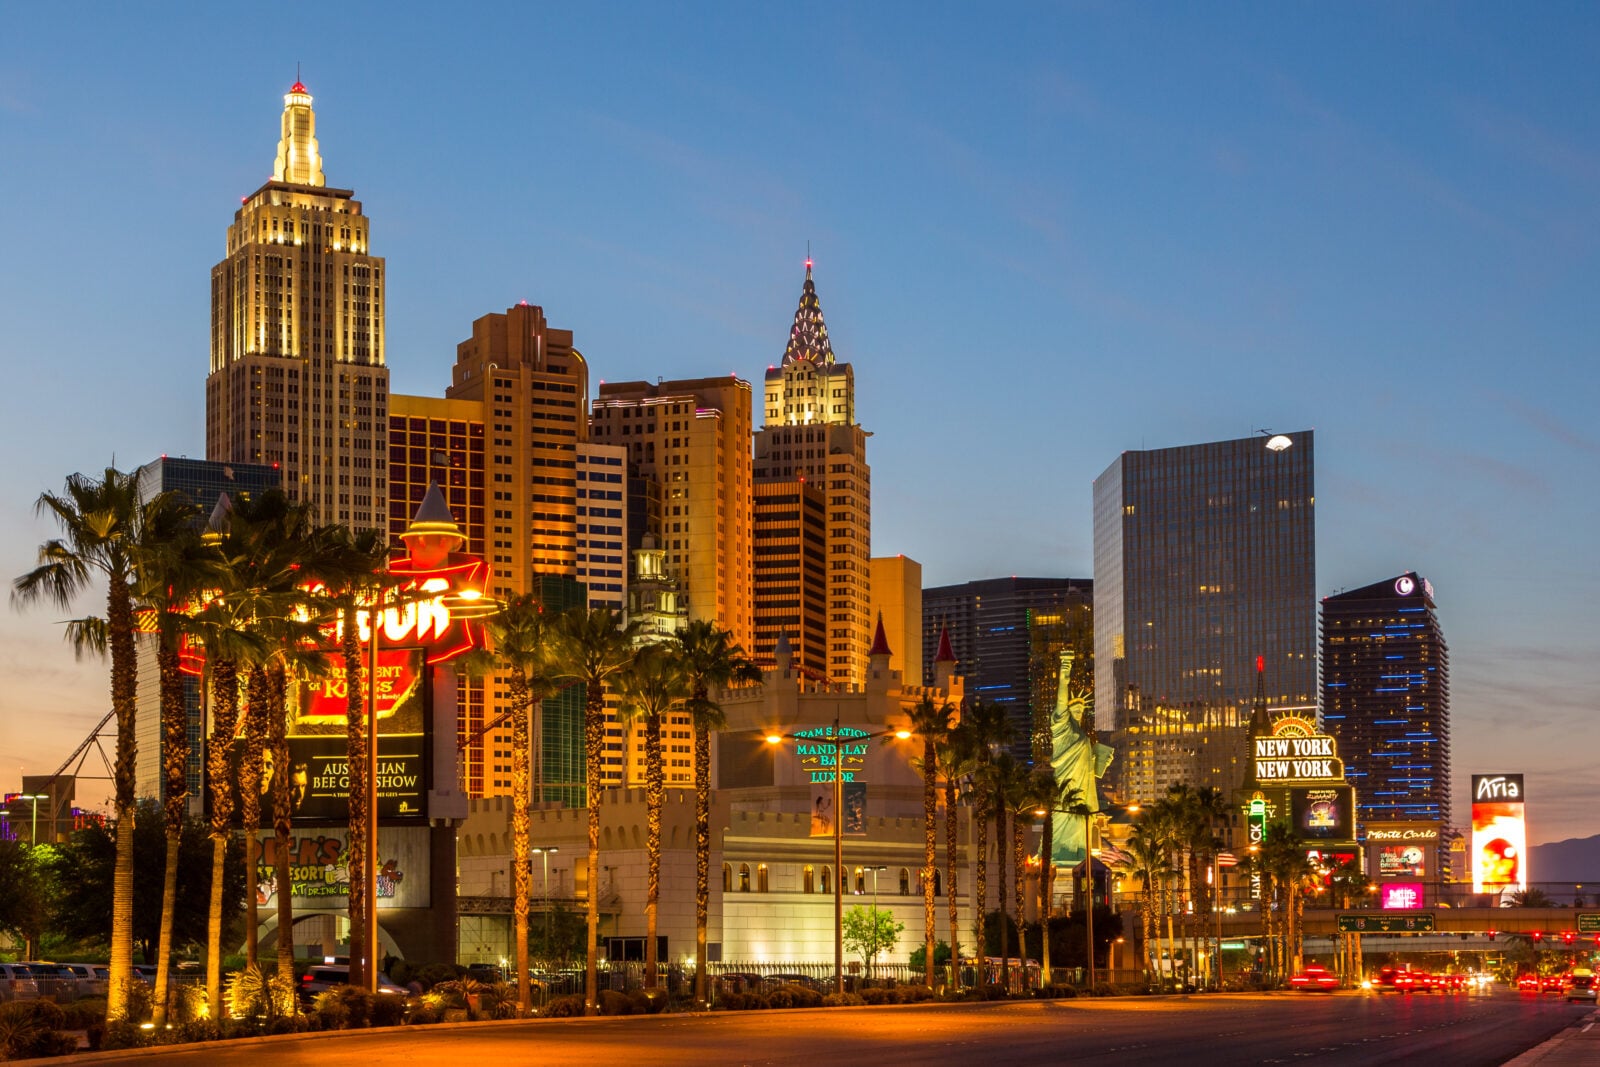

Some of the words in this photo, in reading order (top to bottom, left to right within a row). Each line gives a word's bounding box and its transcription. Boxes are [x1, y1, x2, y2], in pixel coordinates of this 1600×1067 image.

[826, 727, 871, 741] SATION
[1256, 739, 1289, 756] NEW
[1292, 738, 1332, 756] YORK
[323, 762, 405, 776] AUSLIAN
[1256, 761, 1289, 778] NEW
[1292, 760, 1333, 777] YORK
[313, 776, 336, 789] BEE
[376, 775, 417, 788] SHOW
[1477, 777, 1519, 800] Aria
[1367, 830, 1402, 839] Monte
[1403, 829, 1437, 839] Carlo
[288, 866, 326, 881] ESORT
